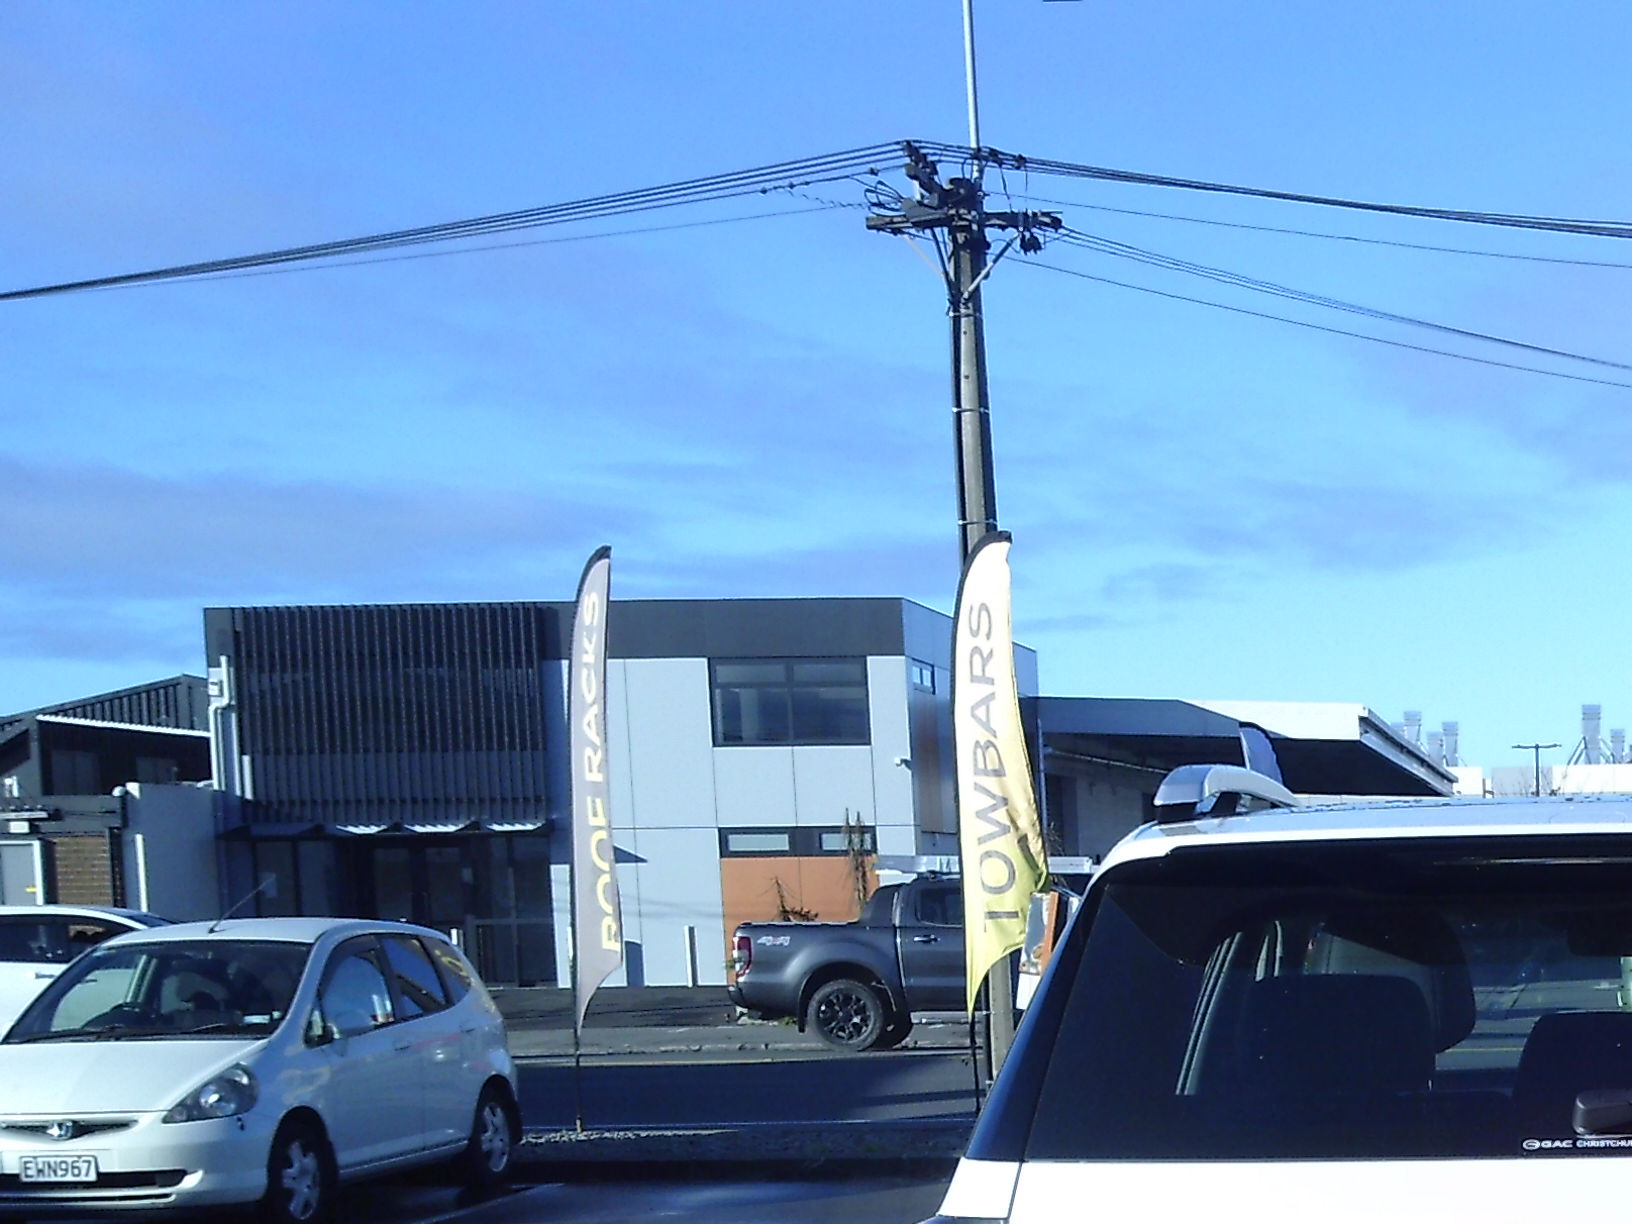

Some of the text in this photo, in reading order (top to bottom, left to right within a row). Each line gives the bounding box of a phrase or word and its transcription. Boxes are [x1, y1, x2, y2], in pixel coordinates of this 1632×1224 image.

[582, 595, 604, 782] RACKS
[968, 601, 1021, 933] TOWBARS
[1541, 1139, 1573, 1148] GAC
